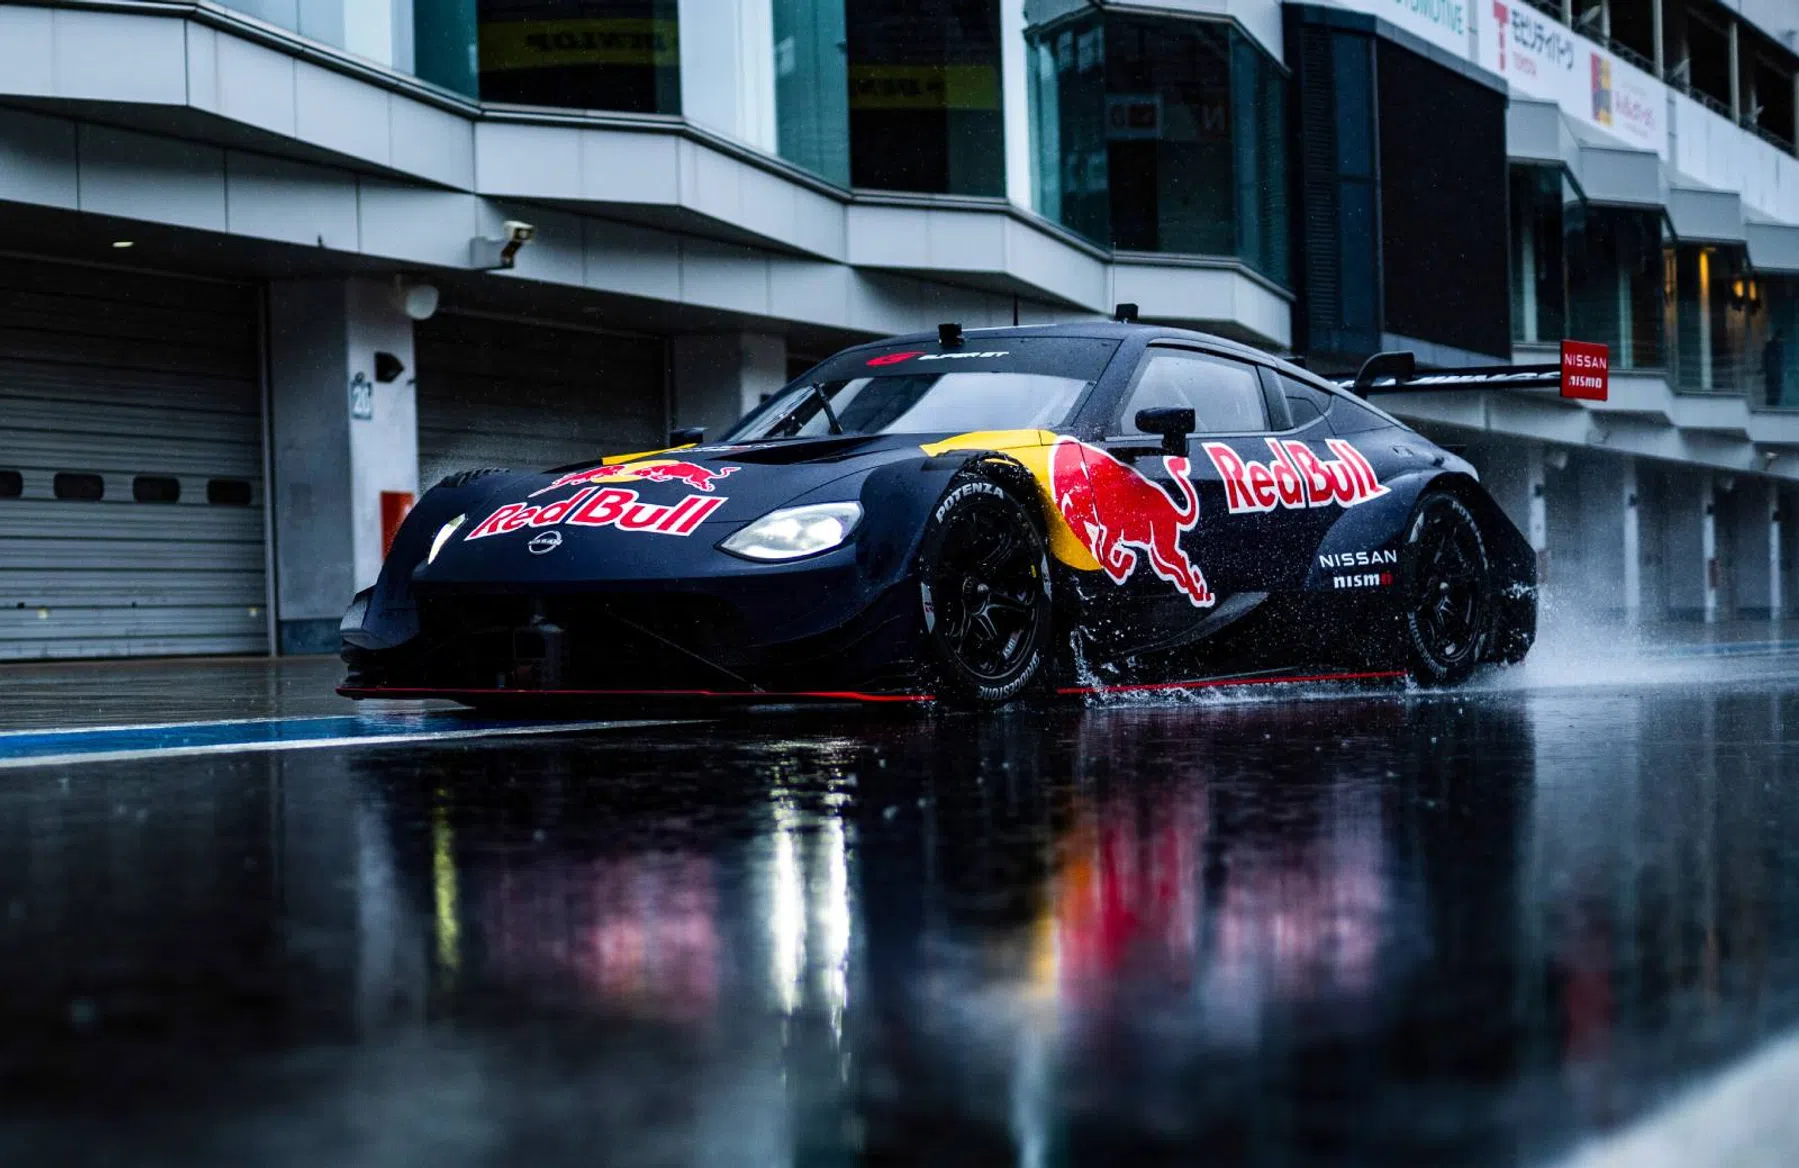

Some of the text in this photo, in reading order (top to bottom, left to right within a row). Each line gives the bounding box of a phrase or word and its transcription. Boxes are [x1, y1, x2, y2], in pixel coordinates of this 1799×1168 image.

[1564, 353, 1607, 370] NISSAN
[1202, 438, 1390, 514] Red Bull
[464, 486, 728, 541] Red Bull
[935, 481, 1004, 523] POTENZA
[1319, 549, 1397, 568] NISSAN
[978, 650, 1040, 701] BRIDGESTONE
